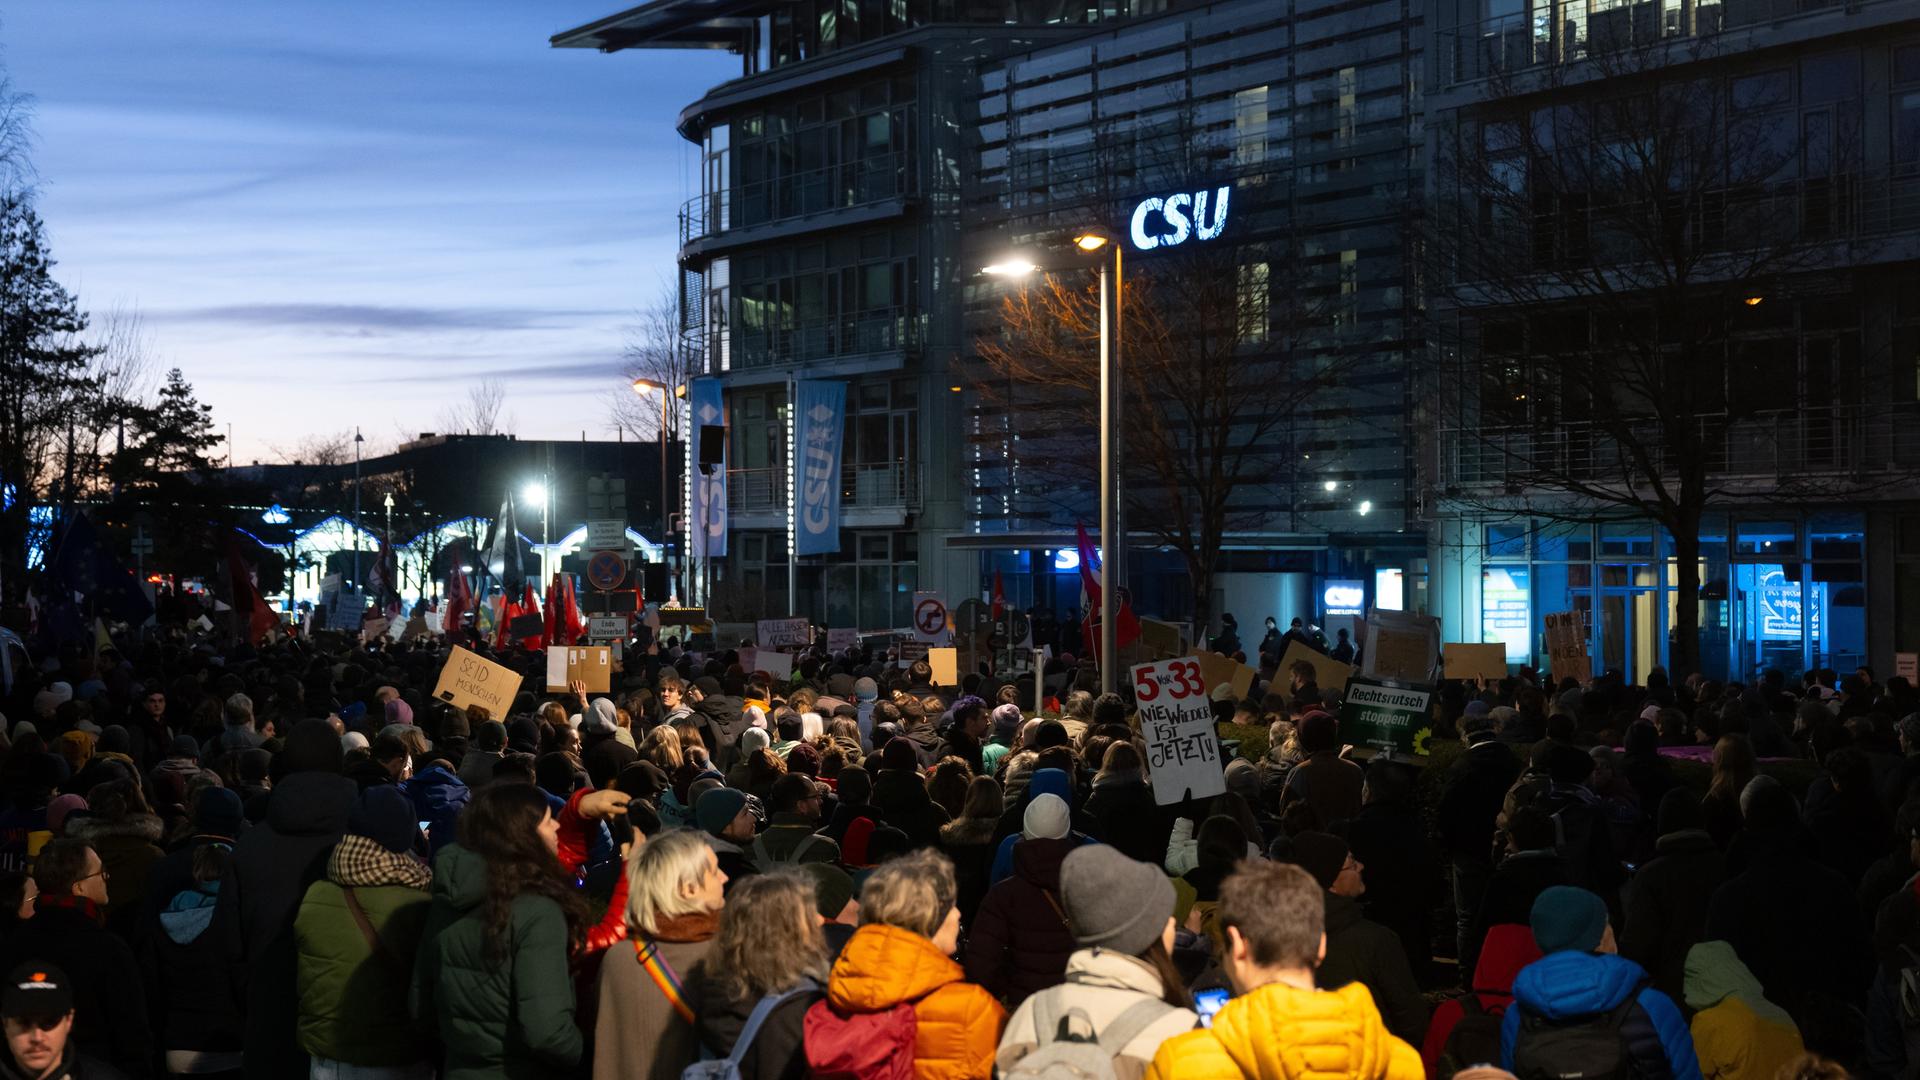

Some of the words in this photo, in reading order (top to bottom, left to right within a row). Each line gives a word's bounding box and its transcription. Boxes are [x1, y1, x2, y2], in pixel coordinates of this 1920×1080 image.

[1131, 186, 1230, 250] CSU
[804, 447, 834, 534] CSU
[460, 657, 489, 682] SEID
[1136, 666, 1160, 702] 5
[1168, 661, 1205, 699] 33
[456, 678, 502, 706] MENSCHEN
[1352, 687, 1424, 708] Rechtsrutsch
[1360, 709, 1410, 727] stoppen!
